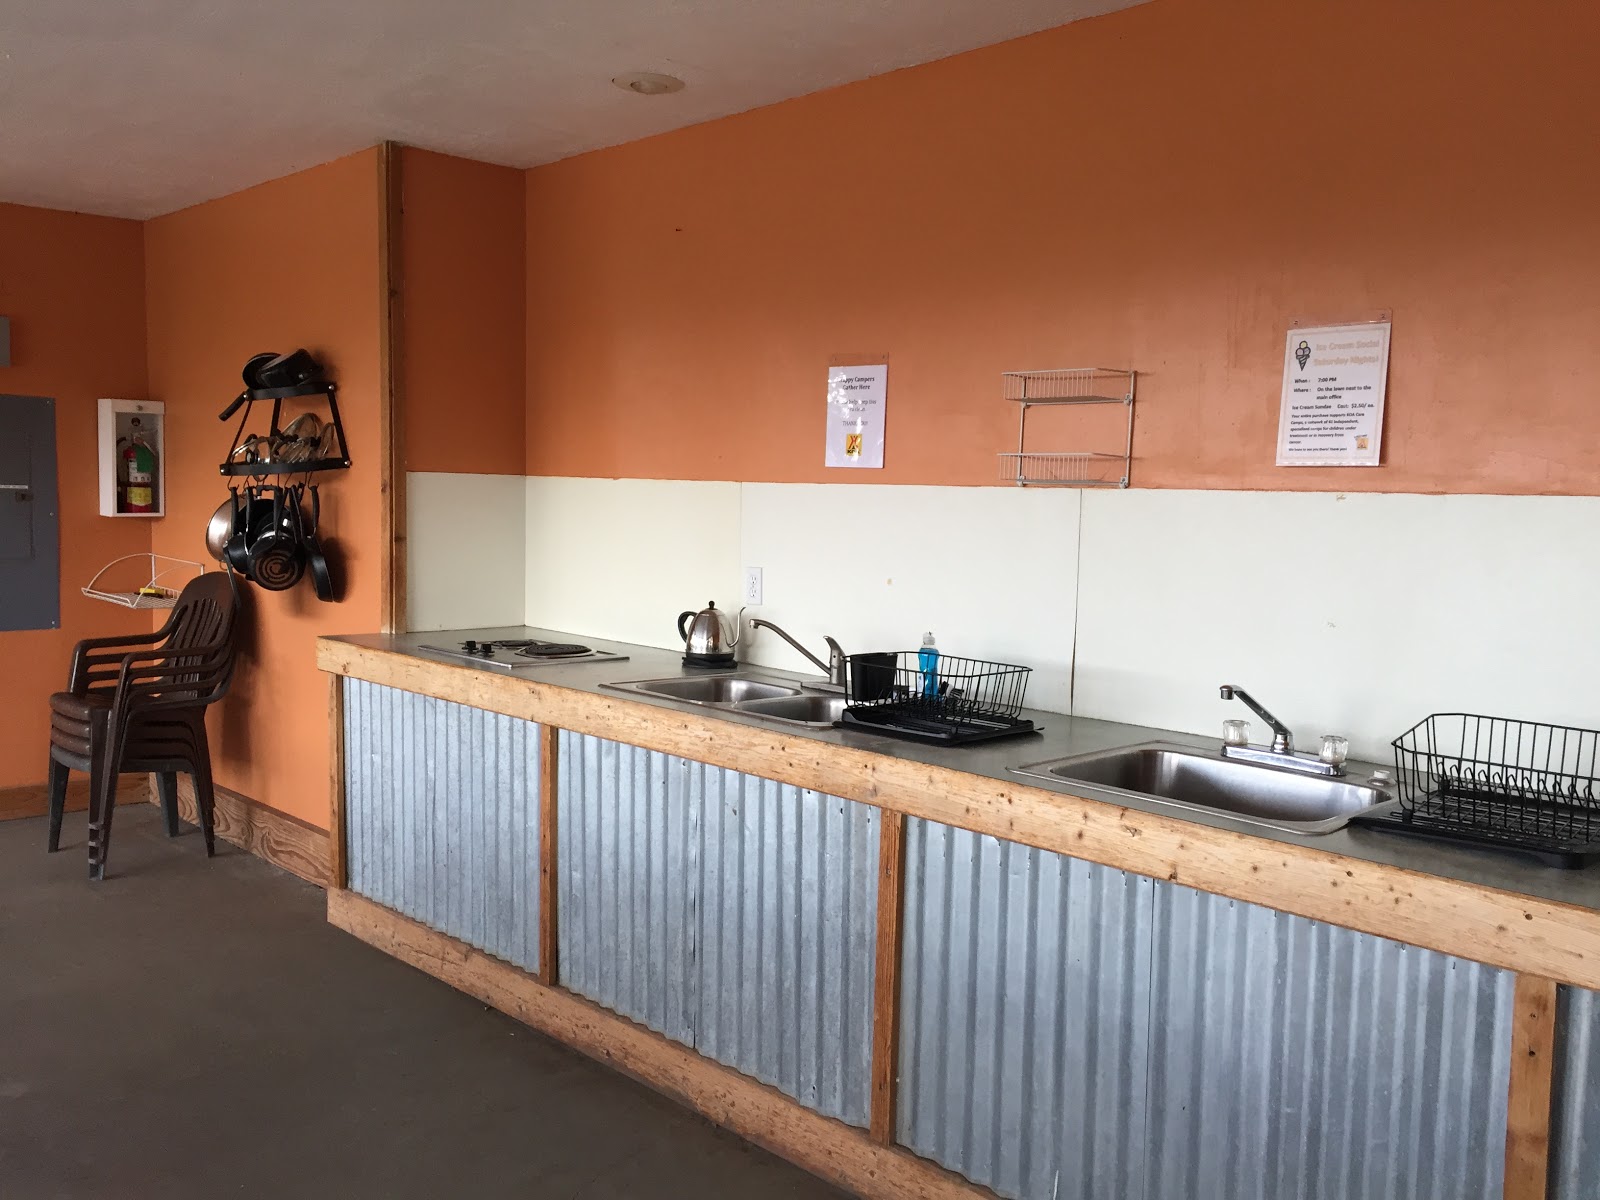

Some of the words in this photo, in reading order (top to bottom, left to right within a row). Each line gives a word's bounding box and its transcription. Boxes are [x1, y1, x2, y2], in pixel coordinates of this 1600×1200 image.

[1329, 342, 1354, 350] Cream
[1356, 340, 1379, 349] Social
[1314, 356, 1349, 366] Saturday
